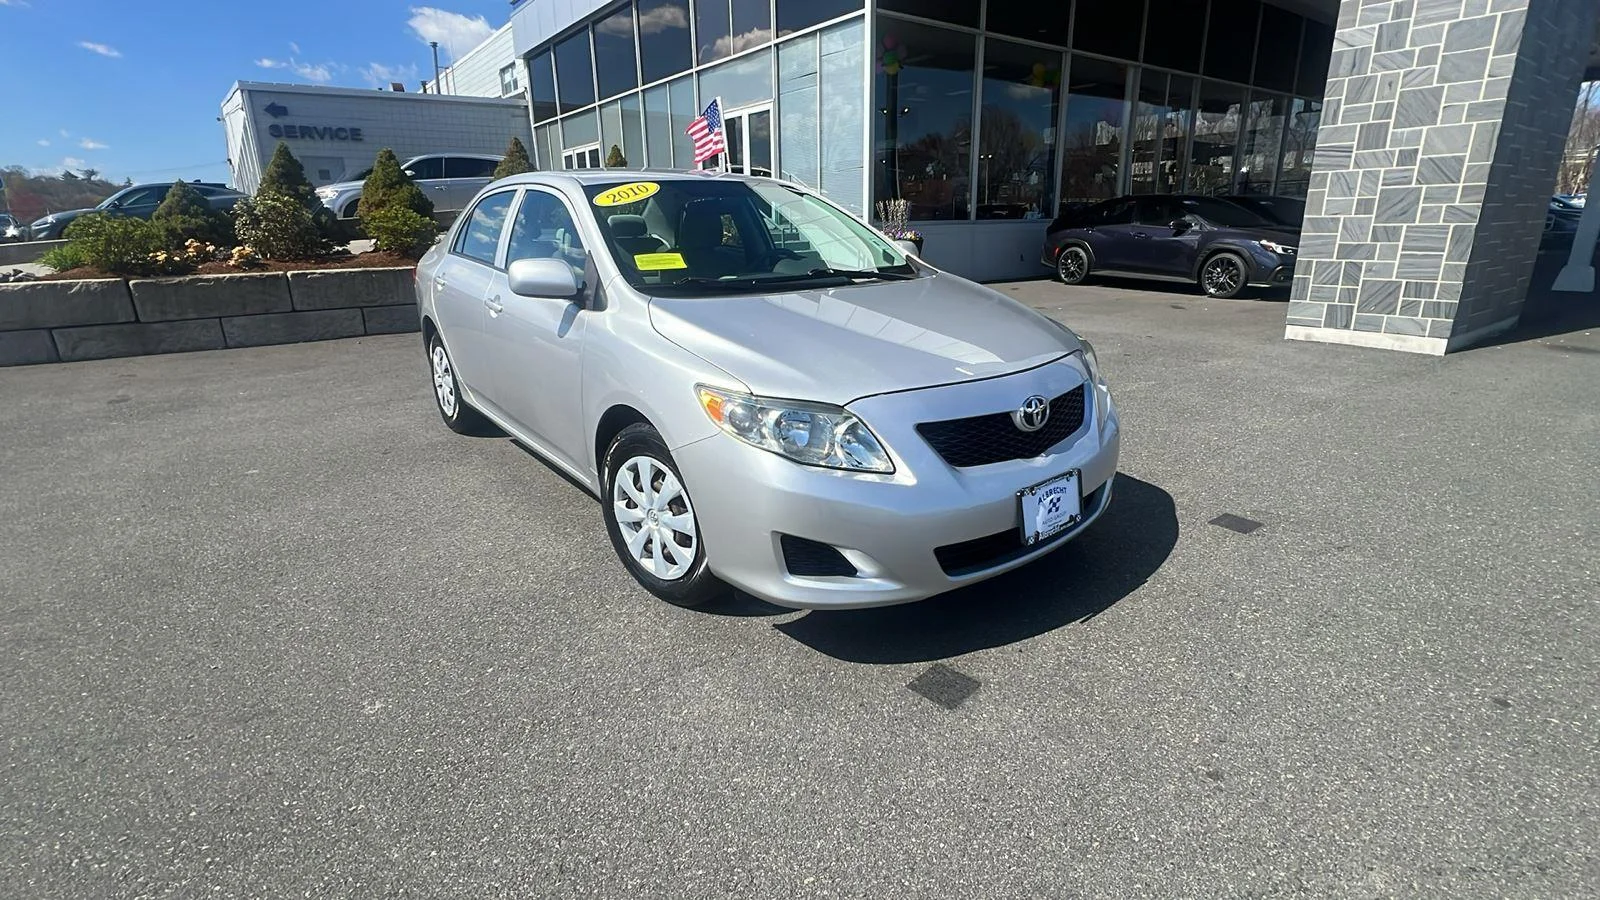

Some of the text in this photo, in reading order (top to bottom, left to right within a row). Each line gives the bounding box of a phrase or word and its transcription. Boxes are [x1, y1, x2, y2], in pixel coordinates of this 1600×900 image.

[269, 124, 364, 142] SERVICE
[606, 184, 649, 203] 2010
[1038, 486, 1067, 505] ALBRECHT
